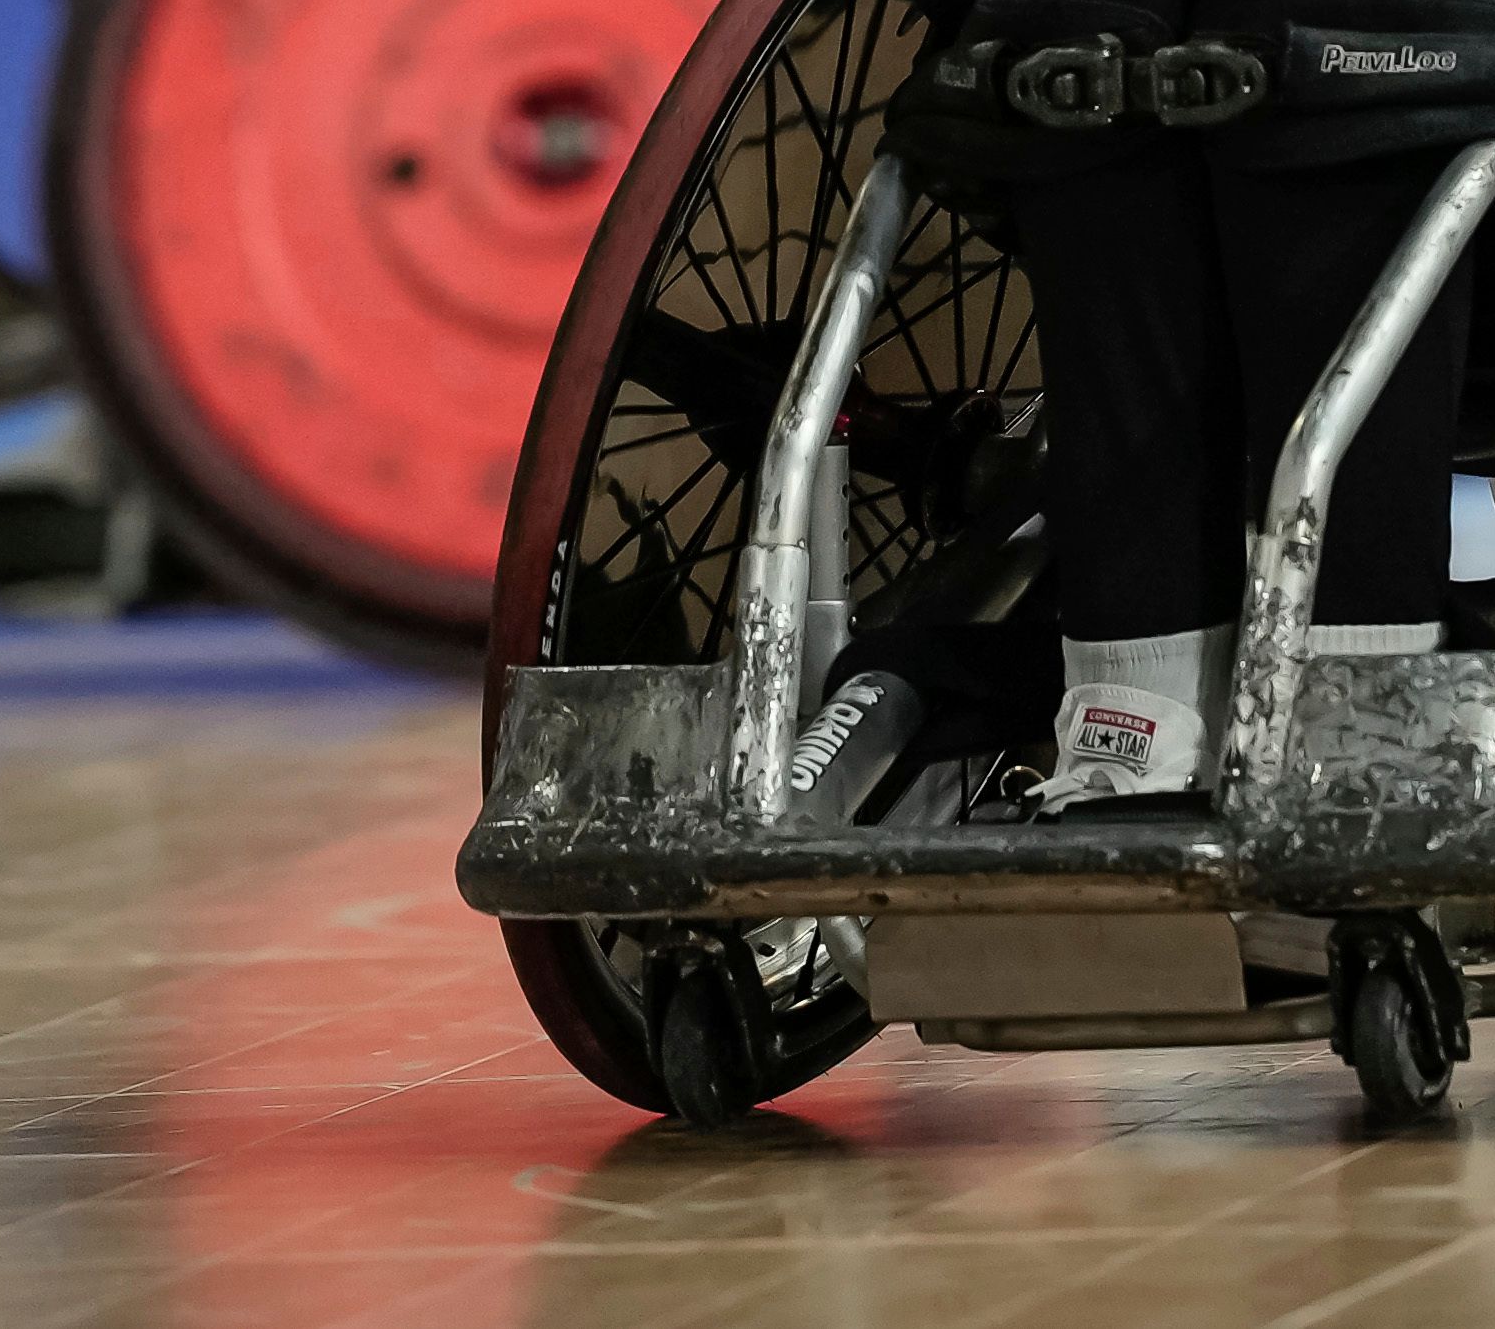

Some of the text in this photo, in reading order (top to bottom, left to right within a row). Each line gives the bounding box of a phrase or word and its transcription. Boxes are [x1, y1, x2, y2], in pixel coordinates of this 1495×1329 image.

[541, 540, 568, 660] ENDA
[1088, 710, 1148, 732] CONVERSE
[1077, 725, 1148, 759] ALL STAR
